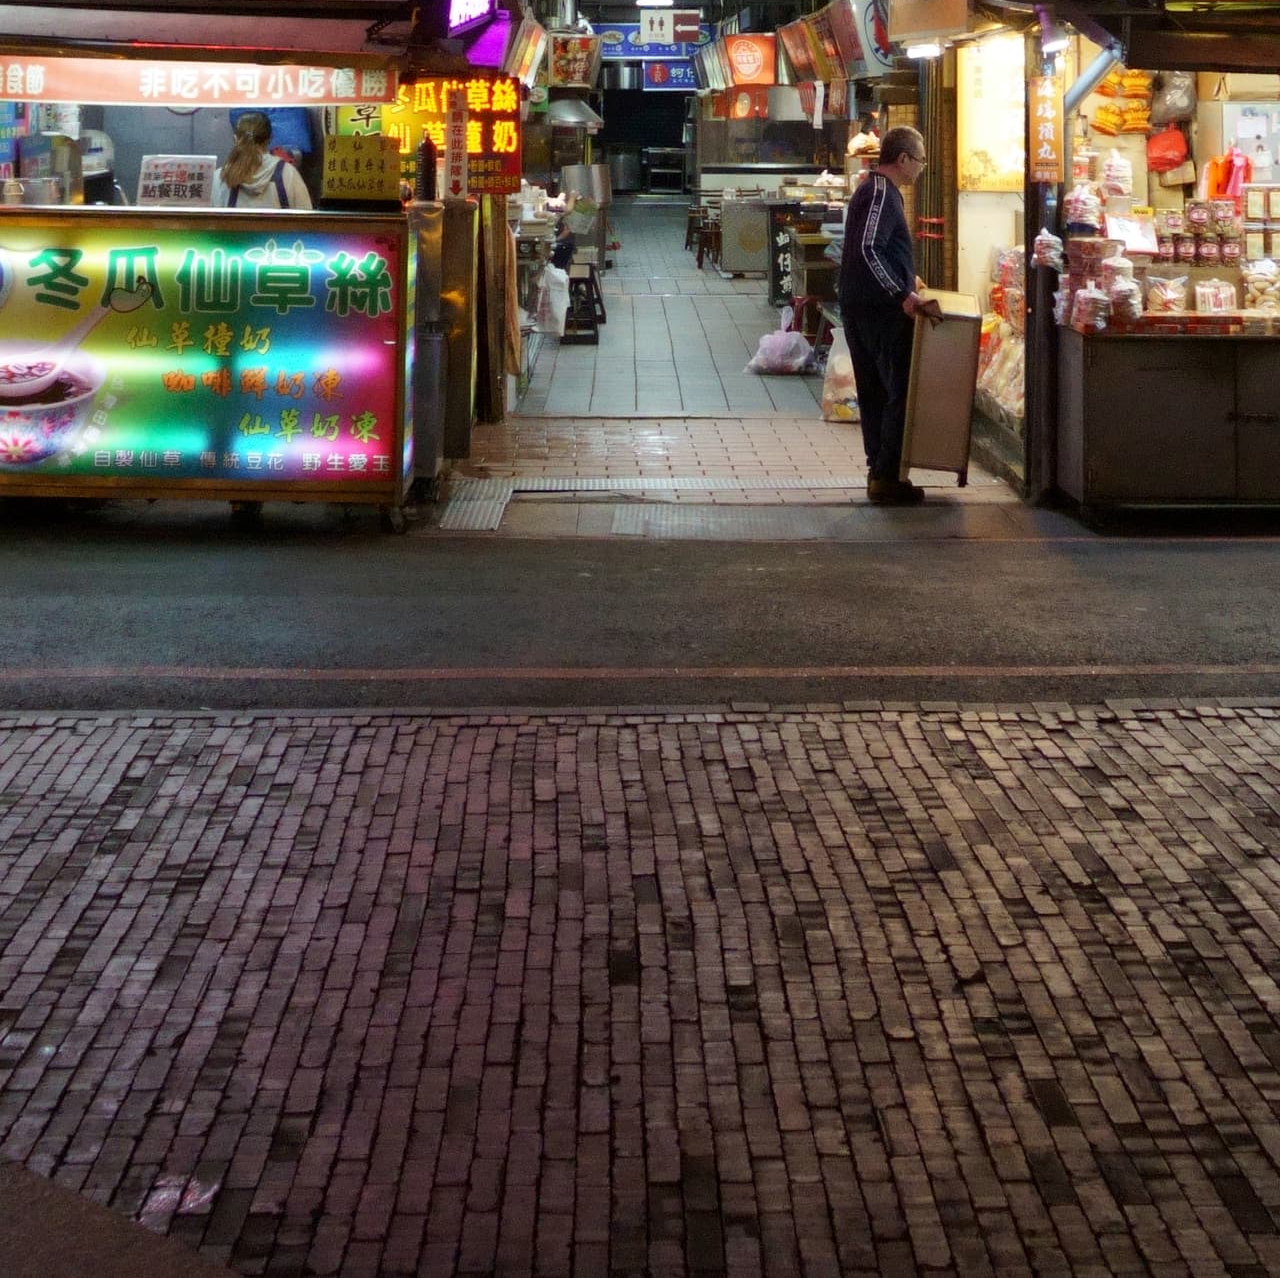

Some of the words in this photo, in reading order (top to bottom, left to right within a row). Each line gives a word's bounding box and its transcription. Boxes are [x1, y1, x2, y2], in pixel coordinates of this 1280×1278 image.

[139, 65, 388, 99] 非吃不可小吃優勝
[26, 240, 393, 317] 冬瓜仙草絲
[239, 412, 382, 445] 仙草奶凍
[94, 450, 182, 469] 自製仙草
[199, 451, 285, 472] 傳統豆花
[302, 452, 393, 474] 野生愛玉
